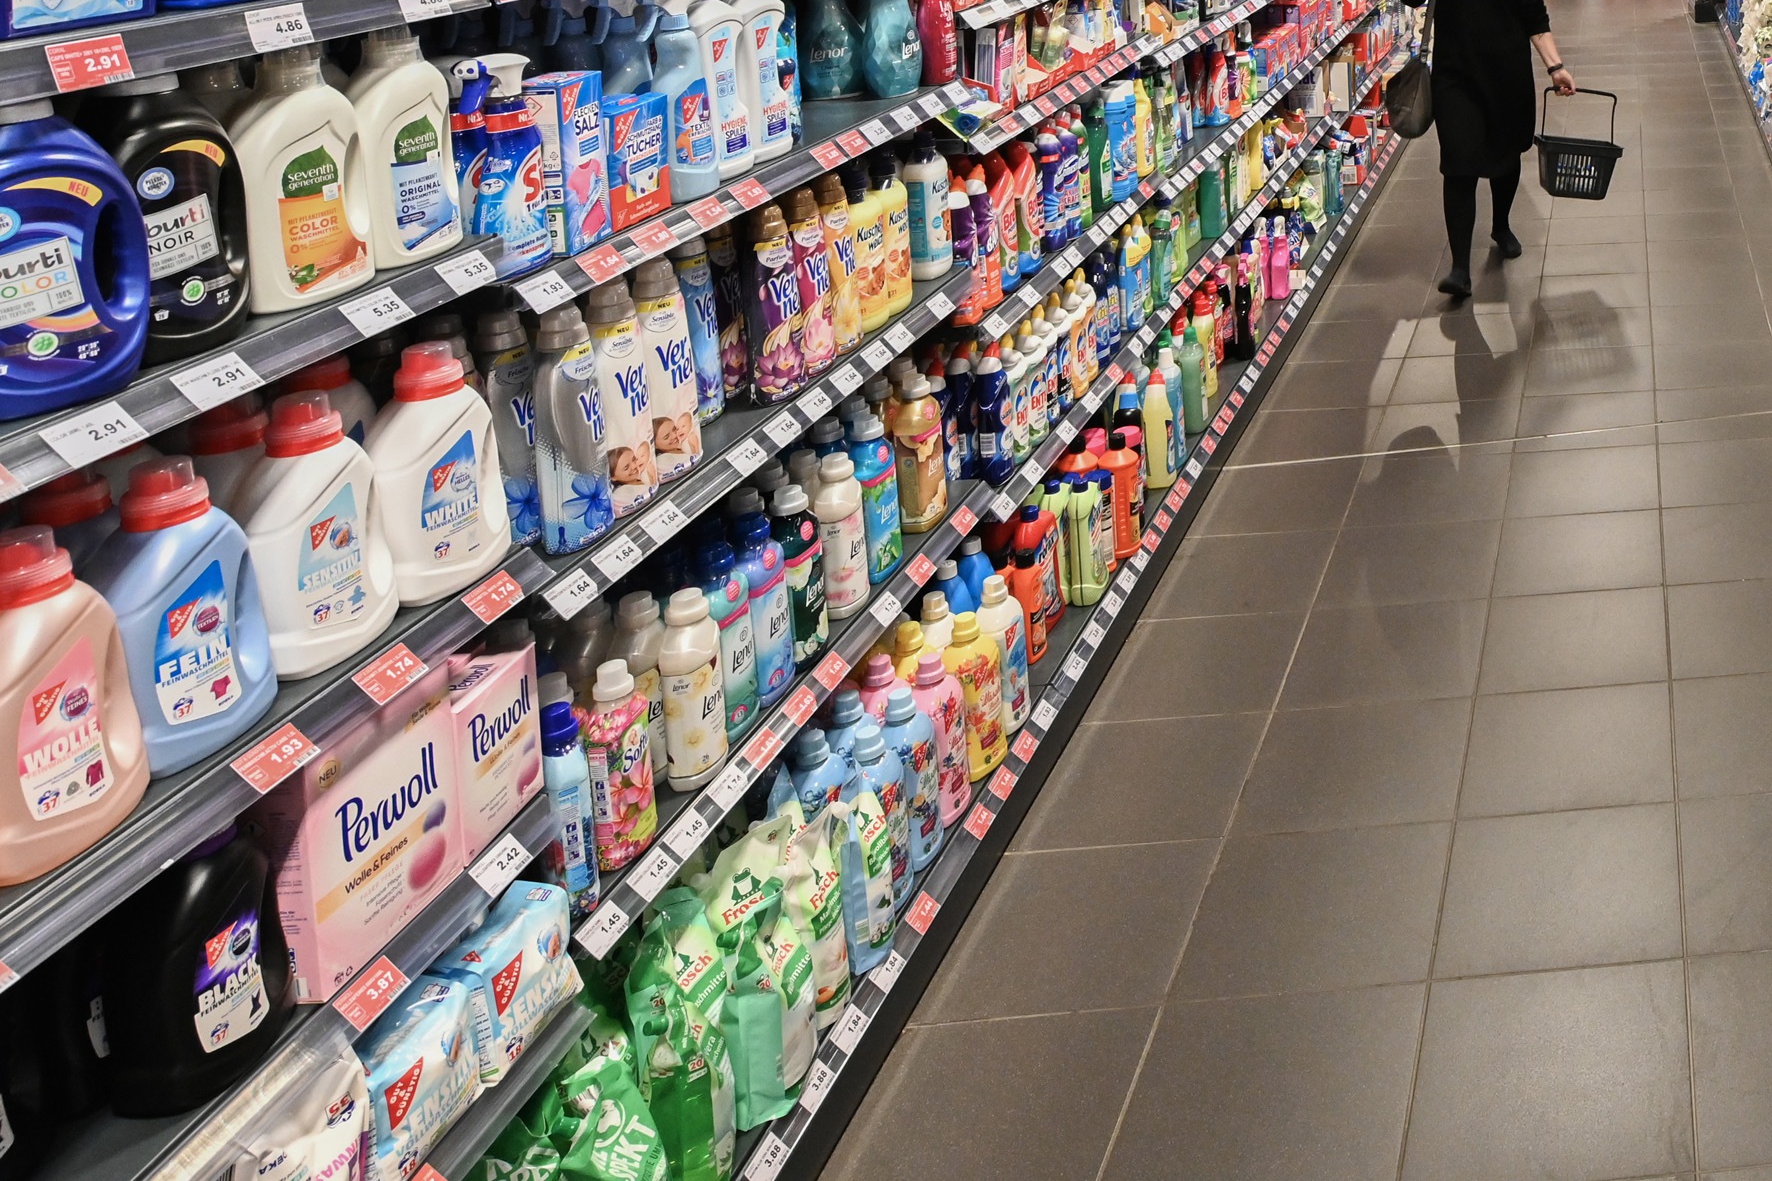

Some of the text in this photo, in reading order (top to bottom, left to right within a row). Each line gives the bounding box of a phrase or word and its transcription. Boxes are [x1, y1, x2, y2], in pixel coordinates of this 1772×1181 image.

[275, 19, 303, 34] 4.86
[84, 53, 122, 73] 2.91
[574, 103, 600, 120] FLECKEN
[575, 117, 600, 137] SALZ
[399, 131, 436, 149] seventh
[399, 139, 436, 156] generation
[626, 132, 662, 158] TÜCHER
[204, 143, 219, 160] NEU
[288, 162, 335, 184] seventh
[288, 173, 335, 190] generation
[68, 180, 90, 198] NEU
[400, 180, 441, 198] ORIGINAL
[400, 189, 441, 204] WASCHMITTEL
[289, 215, 339, 237] COLOR
[290, 225, 340, 243] WASCHMITTEL
[149, 230, 195, 254] NOIR
[465, 261, 488, 279] 5.35
[600, 255, 619, 269] 1.64
[543, 281, 564, 297] 1.93
[373, 299, 400, 318] 5.35
[657, 301, 671, 310] NEU
[617, 325, 630, 335] NEU
[212, 366, 246, 388] 2.91
[813, 396, 828, 409] 1.64
[88, 418, 128, 442] 2.91
[425, 491, 480, 523] WHITE
[660, 511, 680, 527] 1.64
[437, 547, 449, 559] 37
[615, 545, 635, 563] 1.64
[491, 582, 515, 602] 1.74
[569, 580, 591, 598] 1.64
[316, 608, 330, 623] 37
[159, 635, 229, 682] FEIN
[162, 649, 229, 688] FEINWASCHMITTEL
[386, 656, 413, 679] 1.74
[177, 703, 193, 718] 37
[467, 674, 531, 763] Perwoll
[23, 717, 101, 774] WOLLE
[271, 738, 303, 764] 1.93
[319, 765, 338, 785] NEU
[42, 796, 59, 813] 37
[335, 741, 438, 862] Perwoll
[344, 836, 409, 896] Wolle & Feines
[496, 846, 521, 871] 2.42
[649, 857, 669, 879] 1.45
[600, 911, 622, 935] 1.45
[199, 954, 260, 1010] BLACK
[367, 972, 396, 1001] 3.87
[811, 1069, 829, 1092] 3.88
[764, 1144, 782, 1169] 3.88
